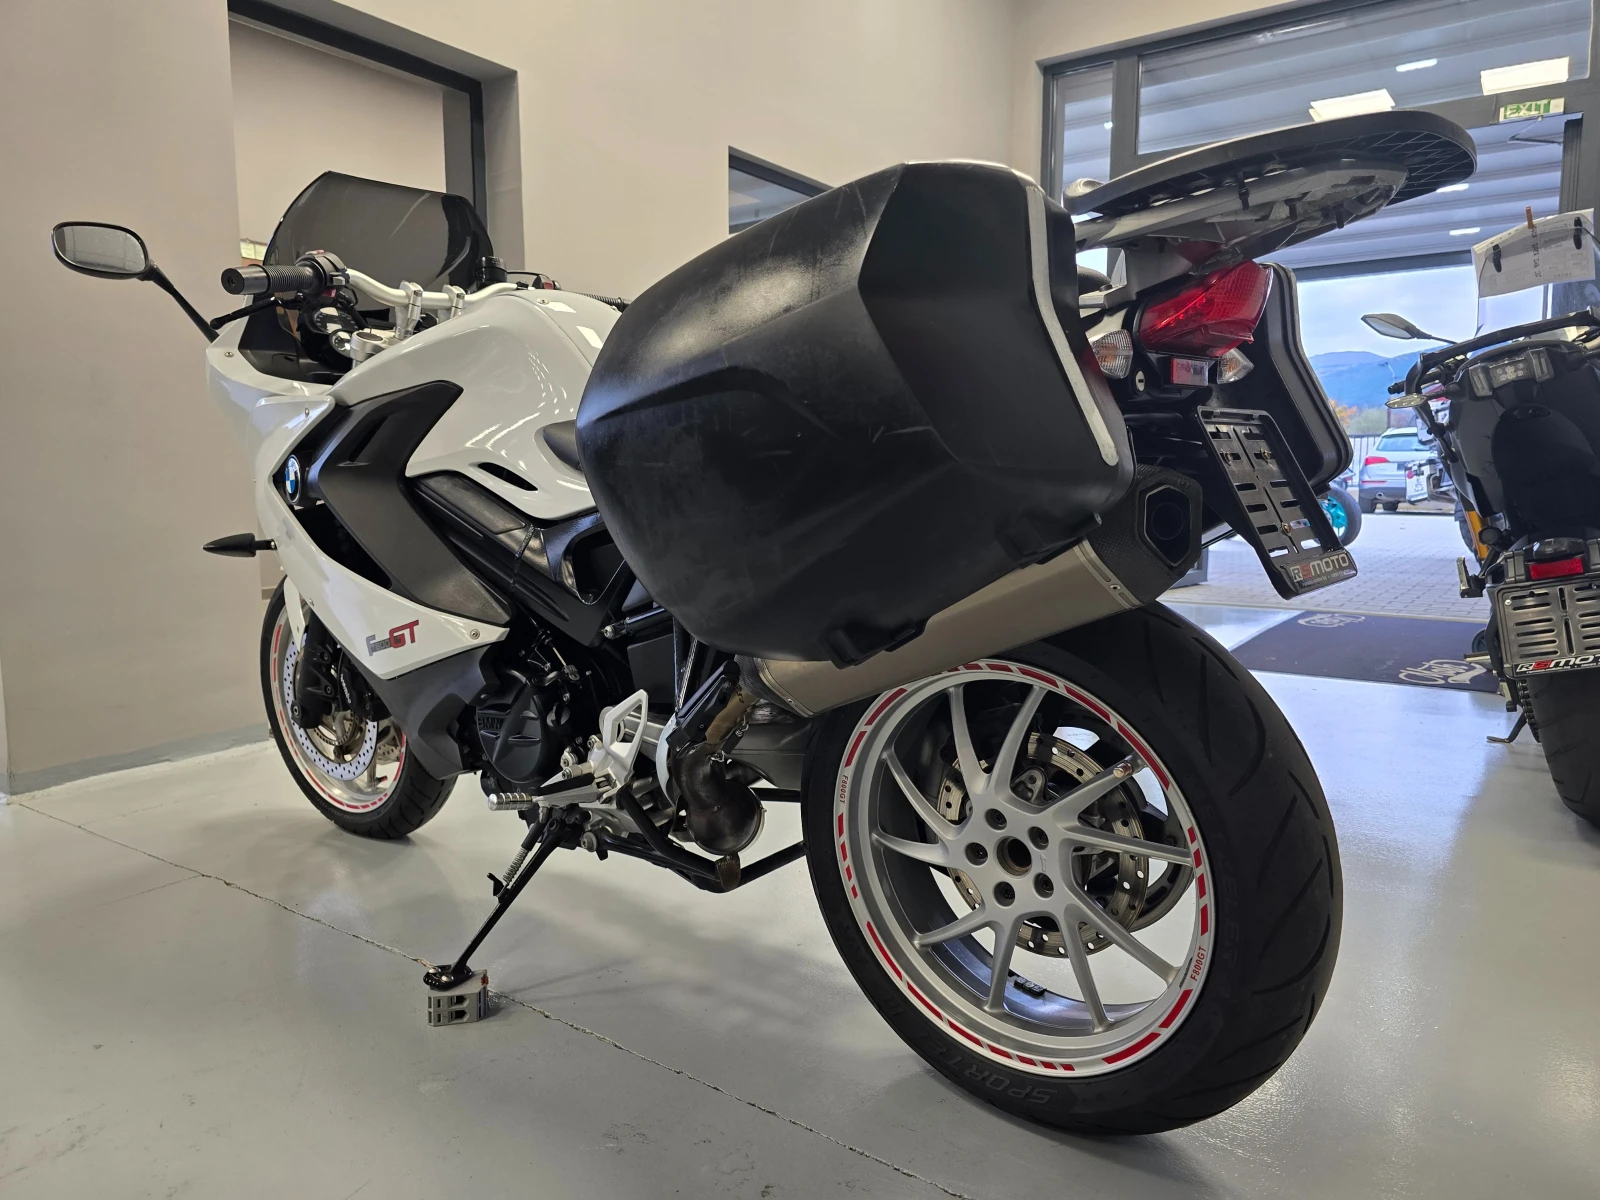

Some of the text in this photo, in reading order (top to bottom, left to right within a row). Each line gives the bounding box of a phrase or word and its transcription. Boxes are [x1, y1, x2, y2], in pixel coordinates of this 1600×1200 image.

[1505, 99, 1550, 118] EXIT
[1289, 553, 1350, 582] RSMOTO
[839, 774, 849, 804] F800GT
[1190, 945, 1206, 982] F800GT
